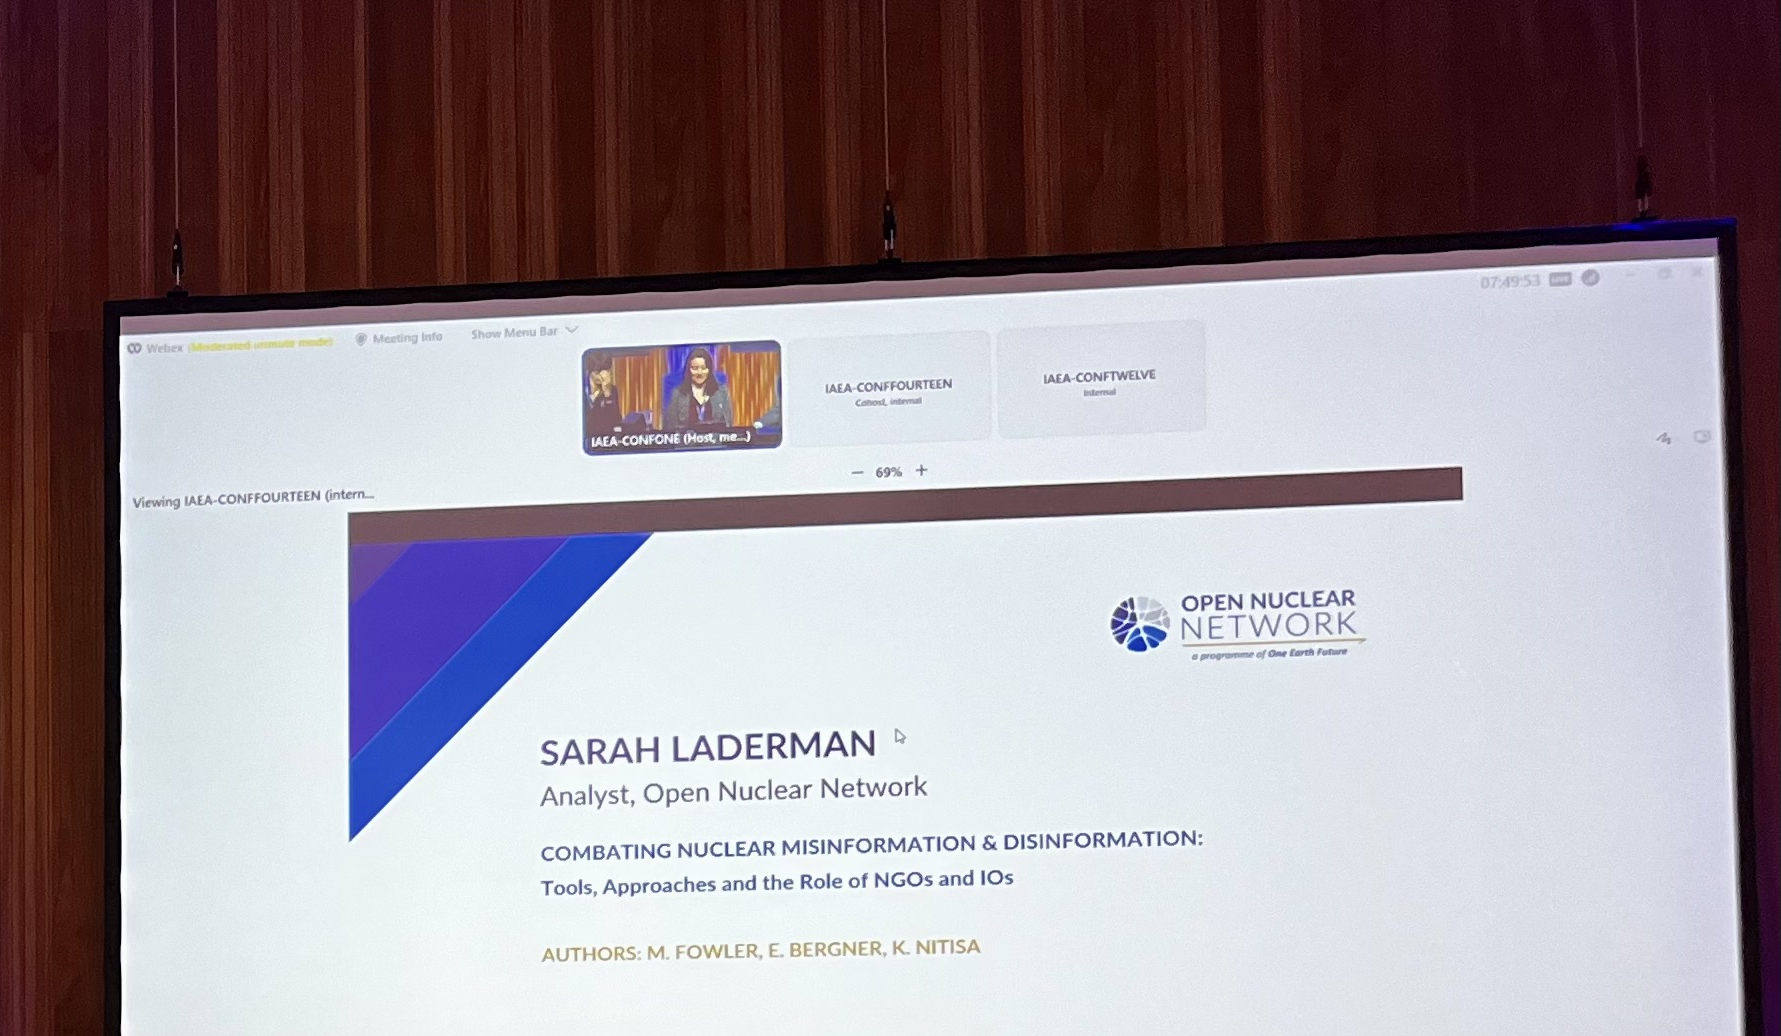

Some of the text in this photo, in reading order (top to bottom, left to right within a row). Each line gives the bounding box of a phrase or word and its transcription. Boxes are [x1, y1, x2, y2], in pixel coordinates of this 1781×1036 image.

[1481, 274, 1540, 289] 07:49:53
[373, 332, 443, 344] Meeting Info
[472, 327, 557, 339] Show Menu Bar
[826, 379, 952, 393] IAEA-CONFFOURTEEN
[1044, 369, 1156, 384] IAEA-CONFTWELVE
[592, 431, 750, 447] IAEA-CONFONE (Host, me...)
[876, 467, 902, 478] 69%
[133, 496, 180, 510] Viewing
[185, 491, 320, 506] IAEA-CONFFOURTEEN
[1182, 590, 1355, 611] OPEN NUCLEAR
[1182, 611, 1356, 640] NETWORK
[541, 730, 875, 766] SARAH LADERMAN
[540, 775, 927, 809] Analyst, Open Nuclear Network
[541, 830, 1202, 861] COMBATING NUCLEAR MISINFORMATION & DISINFORMATION:
[541, 870, 1013, 897] Tools, Approaches and the Role of NGOs and IOs
[542, 939, 980, 962] AUTHORS: M. FOWLER, E. BERGNER, K. NITISA
